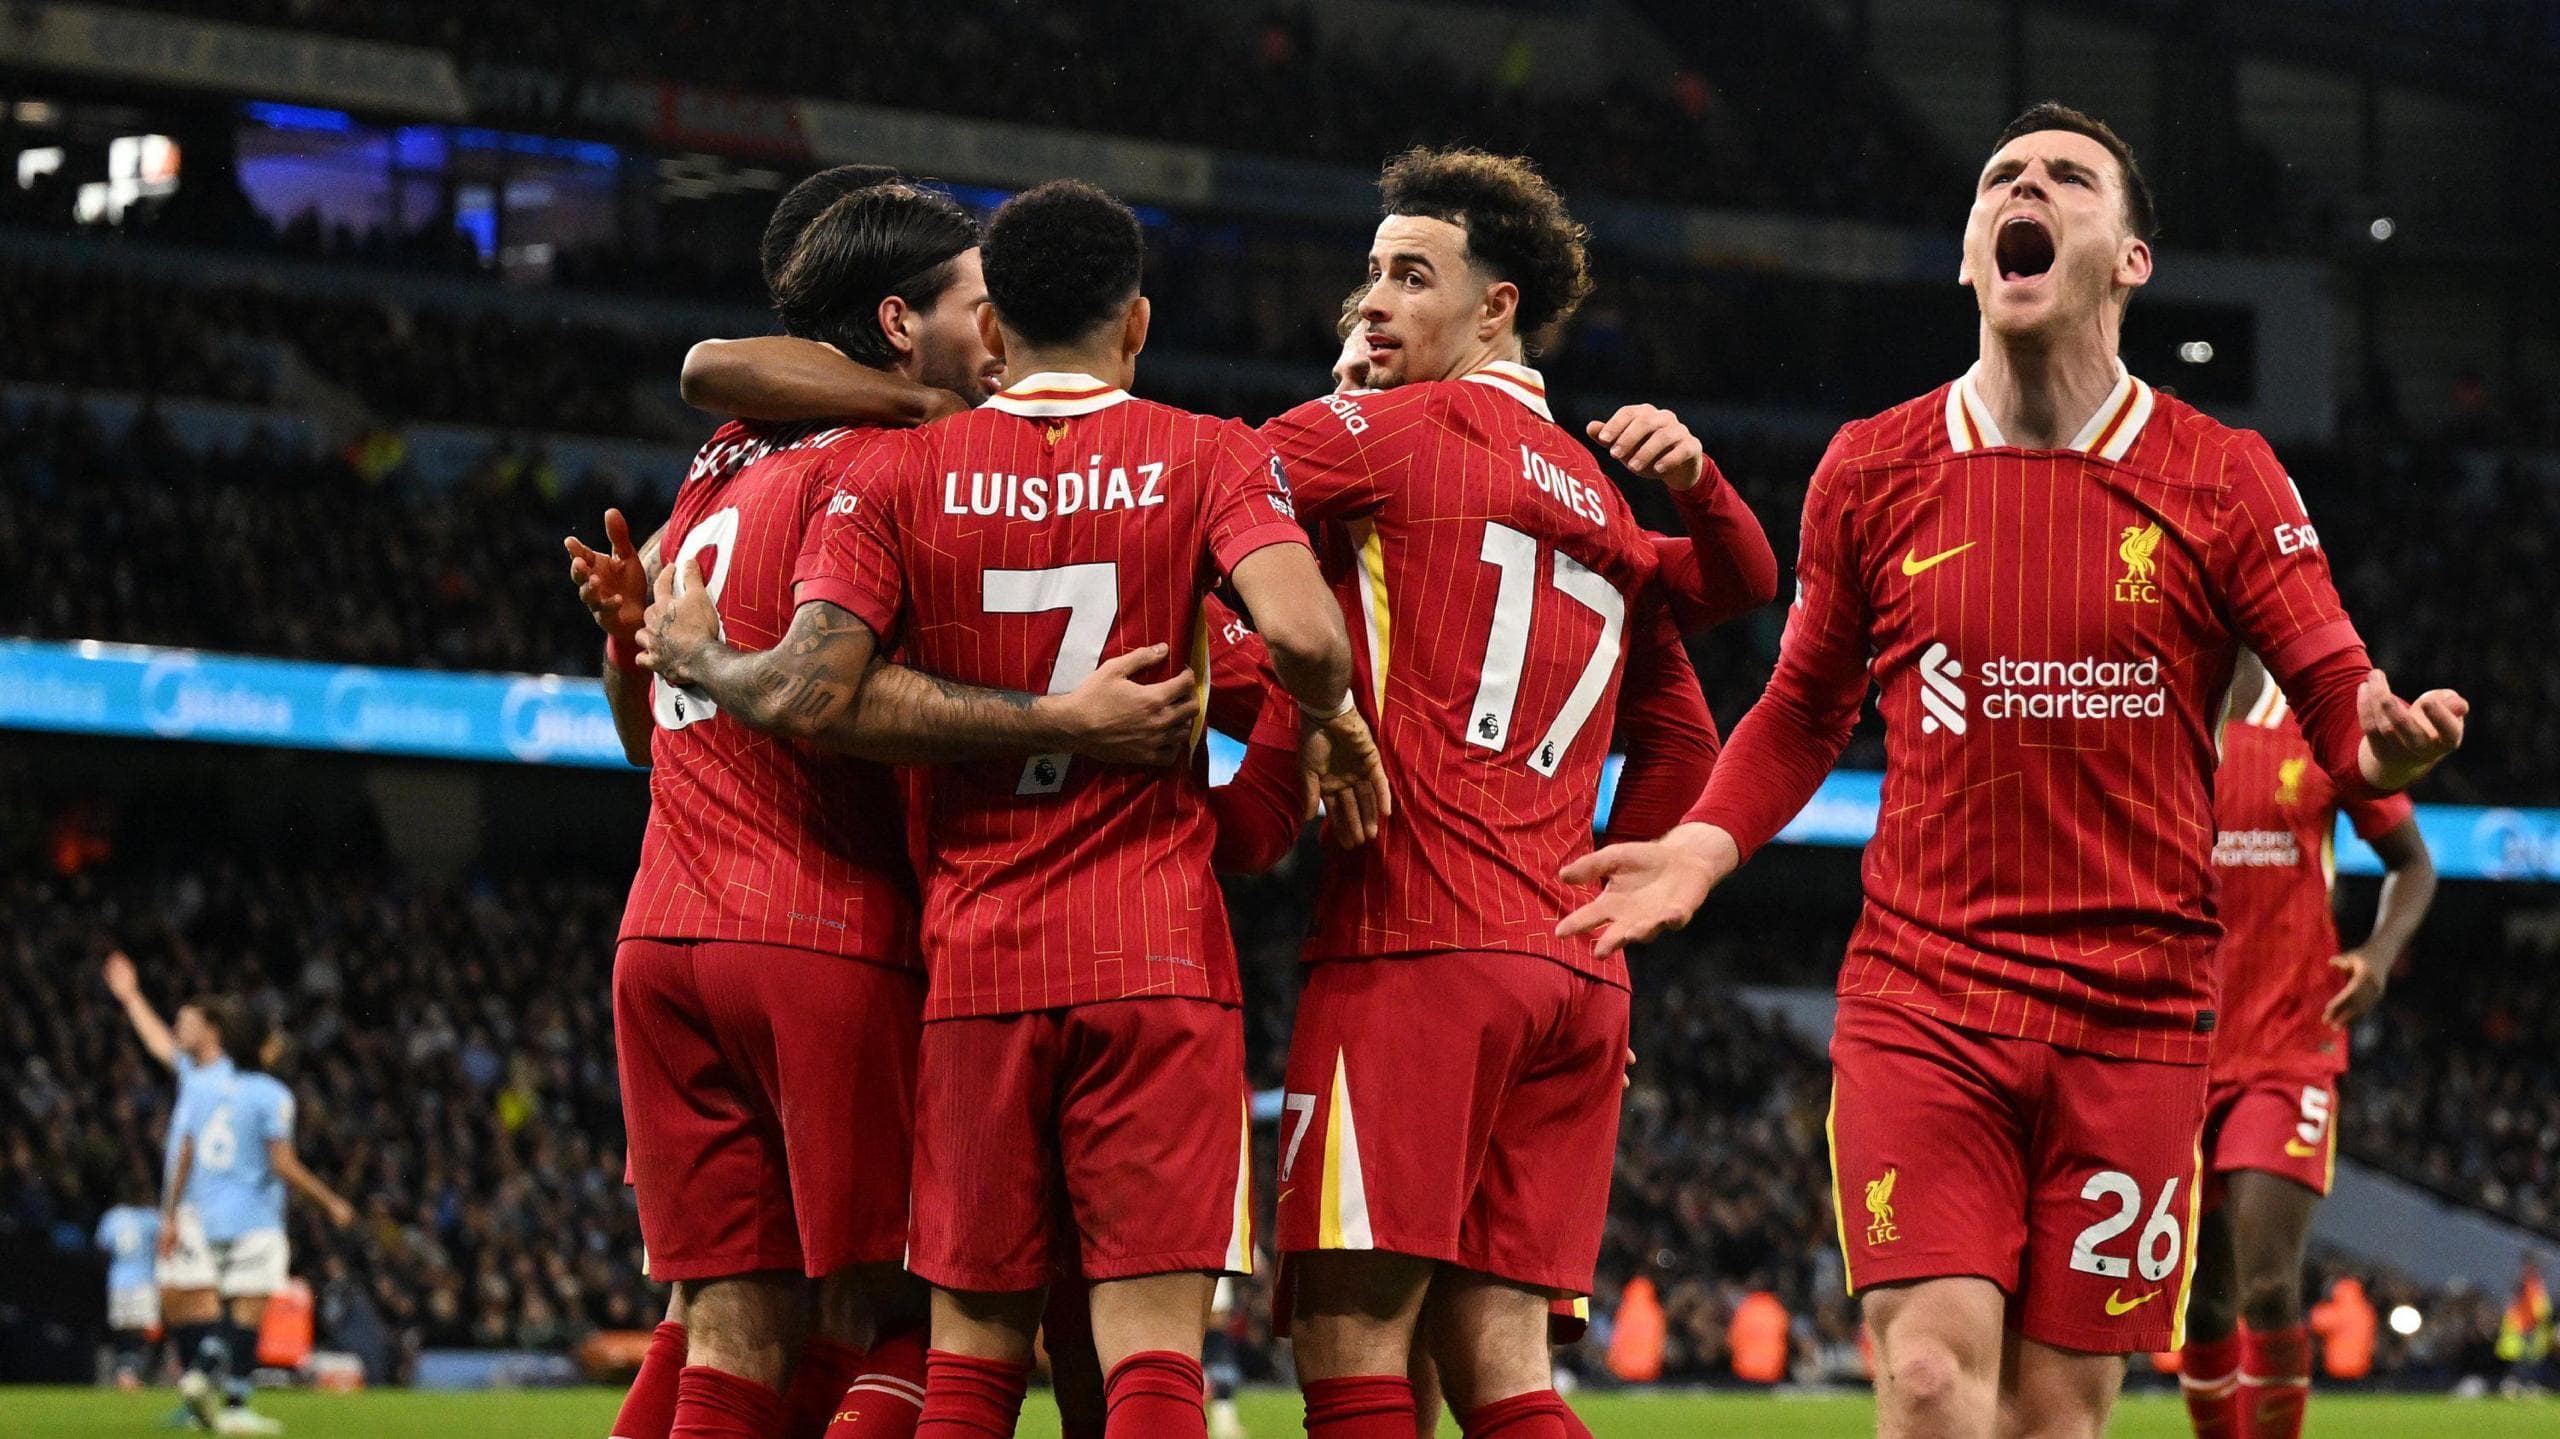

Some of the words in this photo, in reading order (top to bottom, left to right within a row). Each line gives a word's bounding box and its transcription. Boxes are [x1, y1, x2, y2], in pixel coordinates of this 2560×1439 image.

[1520, 444, 1608, 528] JONES
[982, 562, 1120, 796] 7
[1465, 521, 1626, 780] 17
[1981, 655, 2159, 688] standard
[1981, 687, 2166, 720] chartered
[200, 1103, 239, 1171] 6
[2296, 1084, 2331, 1145] 5
[2069, 1170, 2181, 1282] 26
